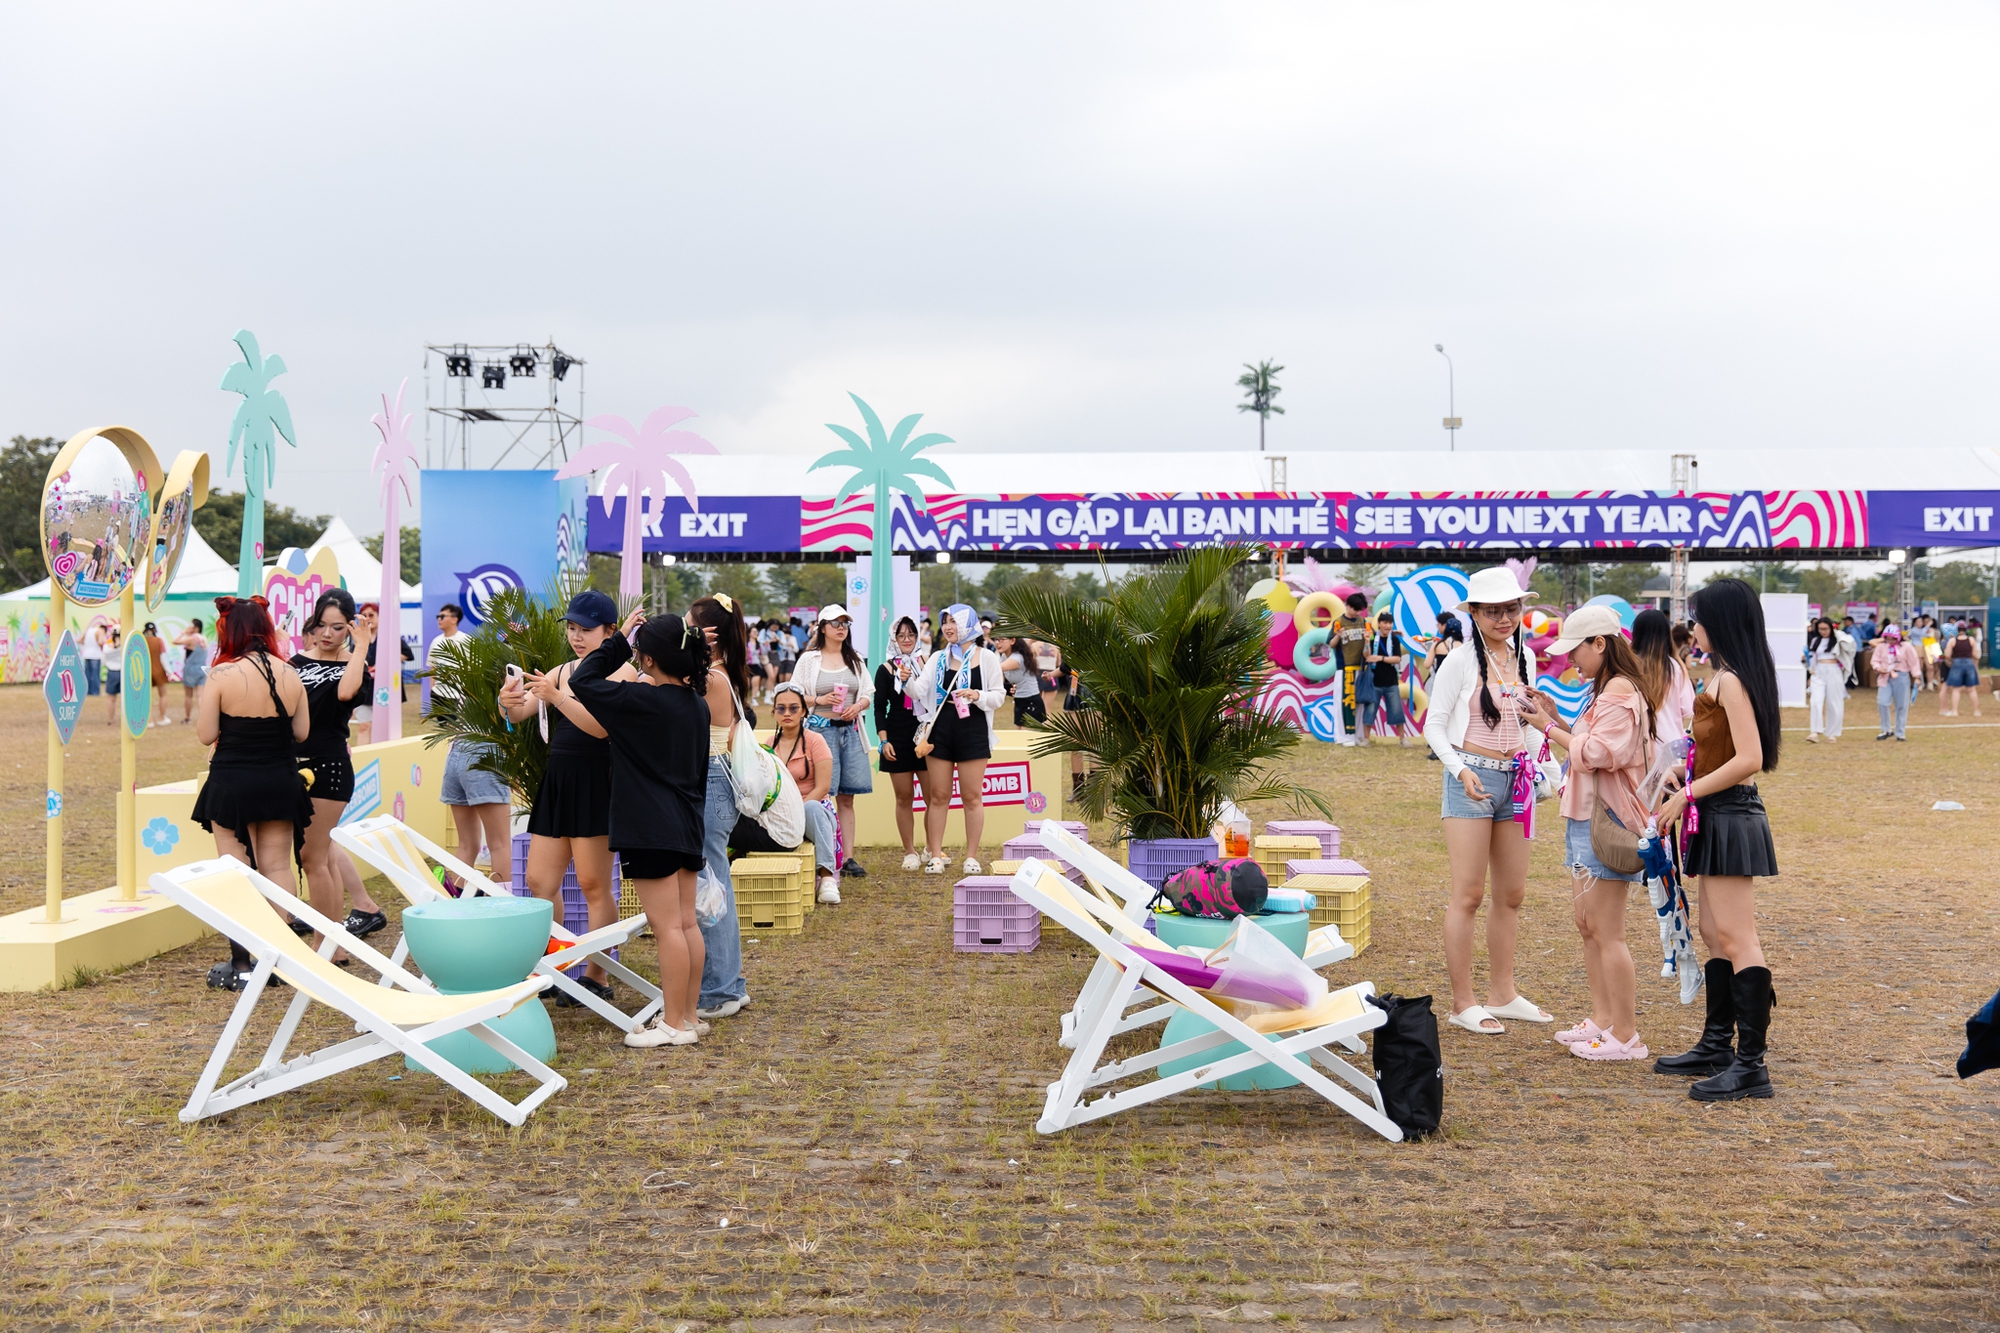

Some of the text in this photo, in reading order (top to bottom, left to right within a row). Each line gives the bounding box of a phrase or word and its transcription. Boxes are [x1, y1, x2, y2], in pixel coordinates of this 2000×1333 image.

[679, 512, 748, 538] EXIT
[973, 499, 1329, 543] HẸN GẶP LẠI BẠN NHÉ
[1354, 505, 1693, 535] SEE YOU NEXT YEAR
[1923, 506, 1995, 533] EXIT
[60, 655, 76, 667] HIGHT
[58, 706, 76, 721] SURF
